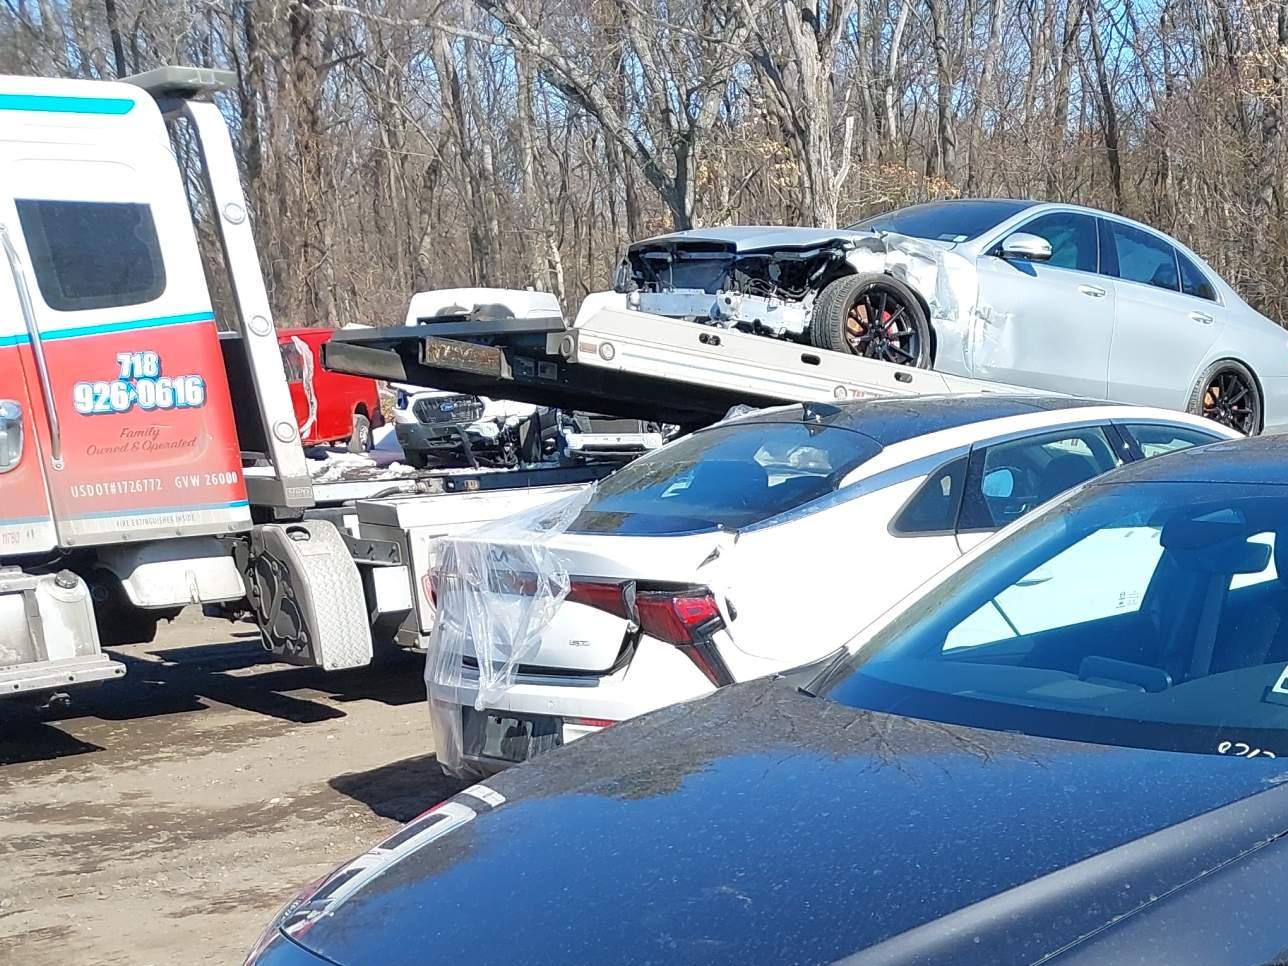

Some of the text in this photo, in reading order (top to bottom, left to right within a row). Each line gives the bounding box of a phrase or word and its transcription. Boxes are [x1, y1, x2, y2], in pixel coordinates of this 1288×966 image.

[117, 351, 161, 379] 718
[73, 375, 207, 416] 926-0616
[86, 436, 198, 457] Owned & Operated
[120, 426, 160, 441] Family
[70, 471, 239, 498] USDOT#1726772 GVW 26000
